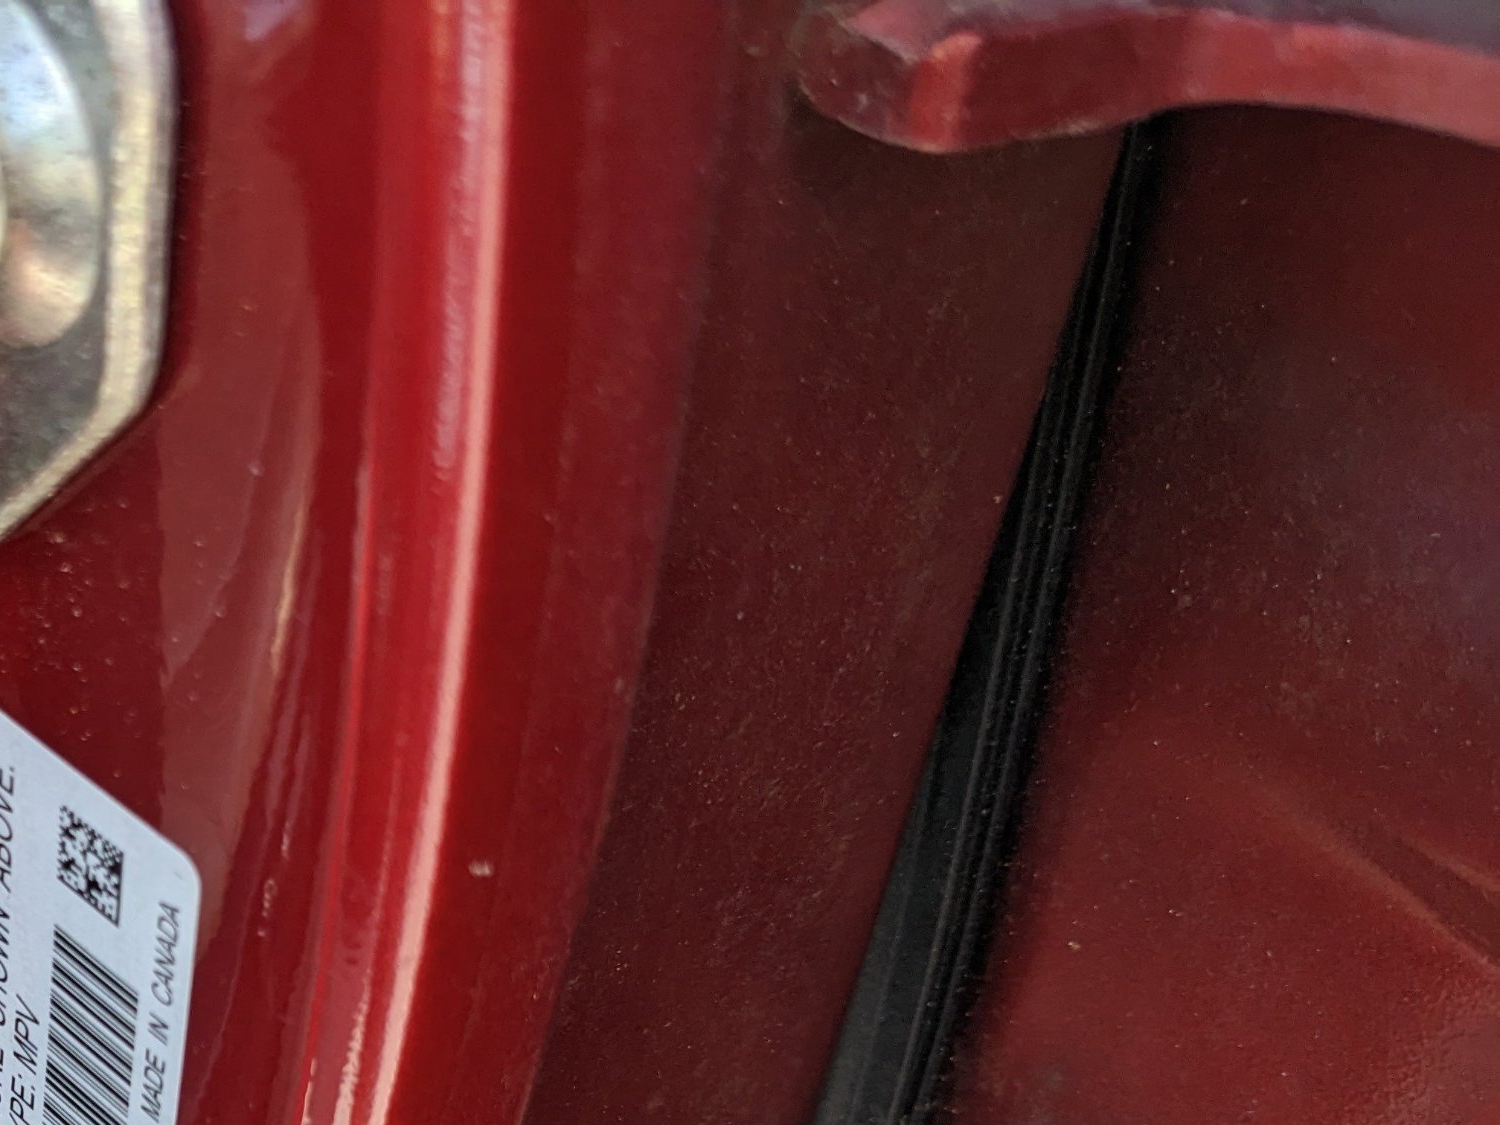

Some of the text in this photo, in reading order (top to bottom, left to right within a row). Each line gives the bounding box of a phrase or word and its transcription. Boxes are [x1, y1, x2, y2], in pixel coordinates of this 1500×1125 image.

[12, 993, 40, 1075] MPV
[140, 901, 179, 1124] MADE IN CANADA
